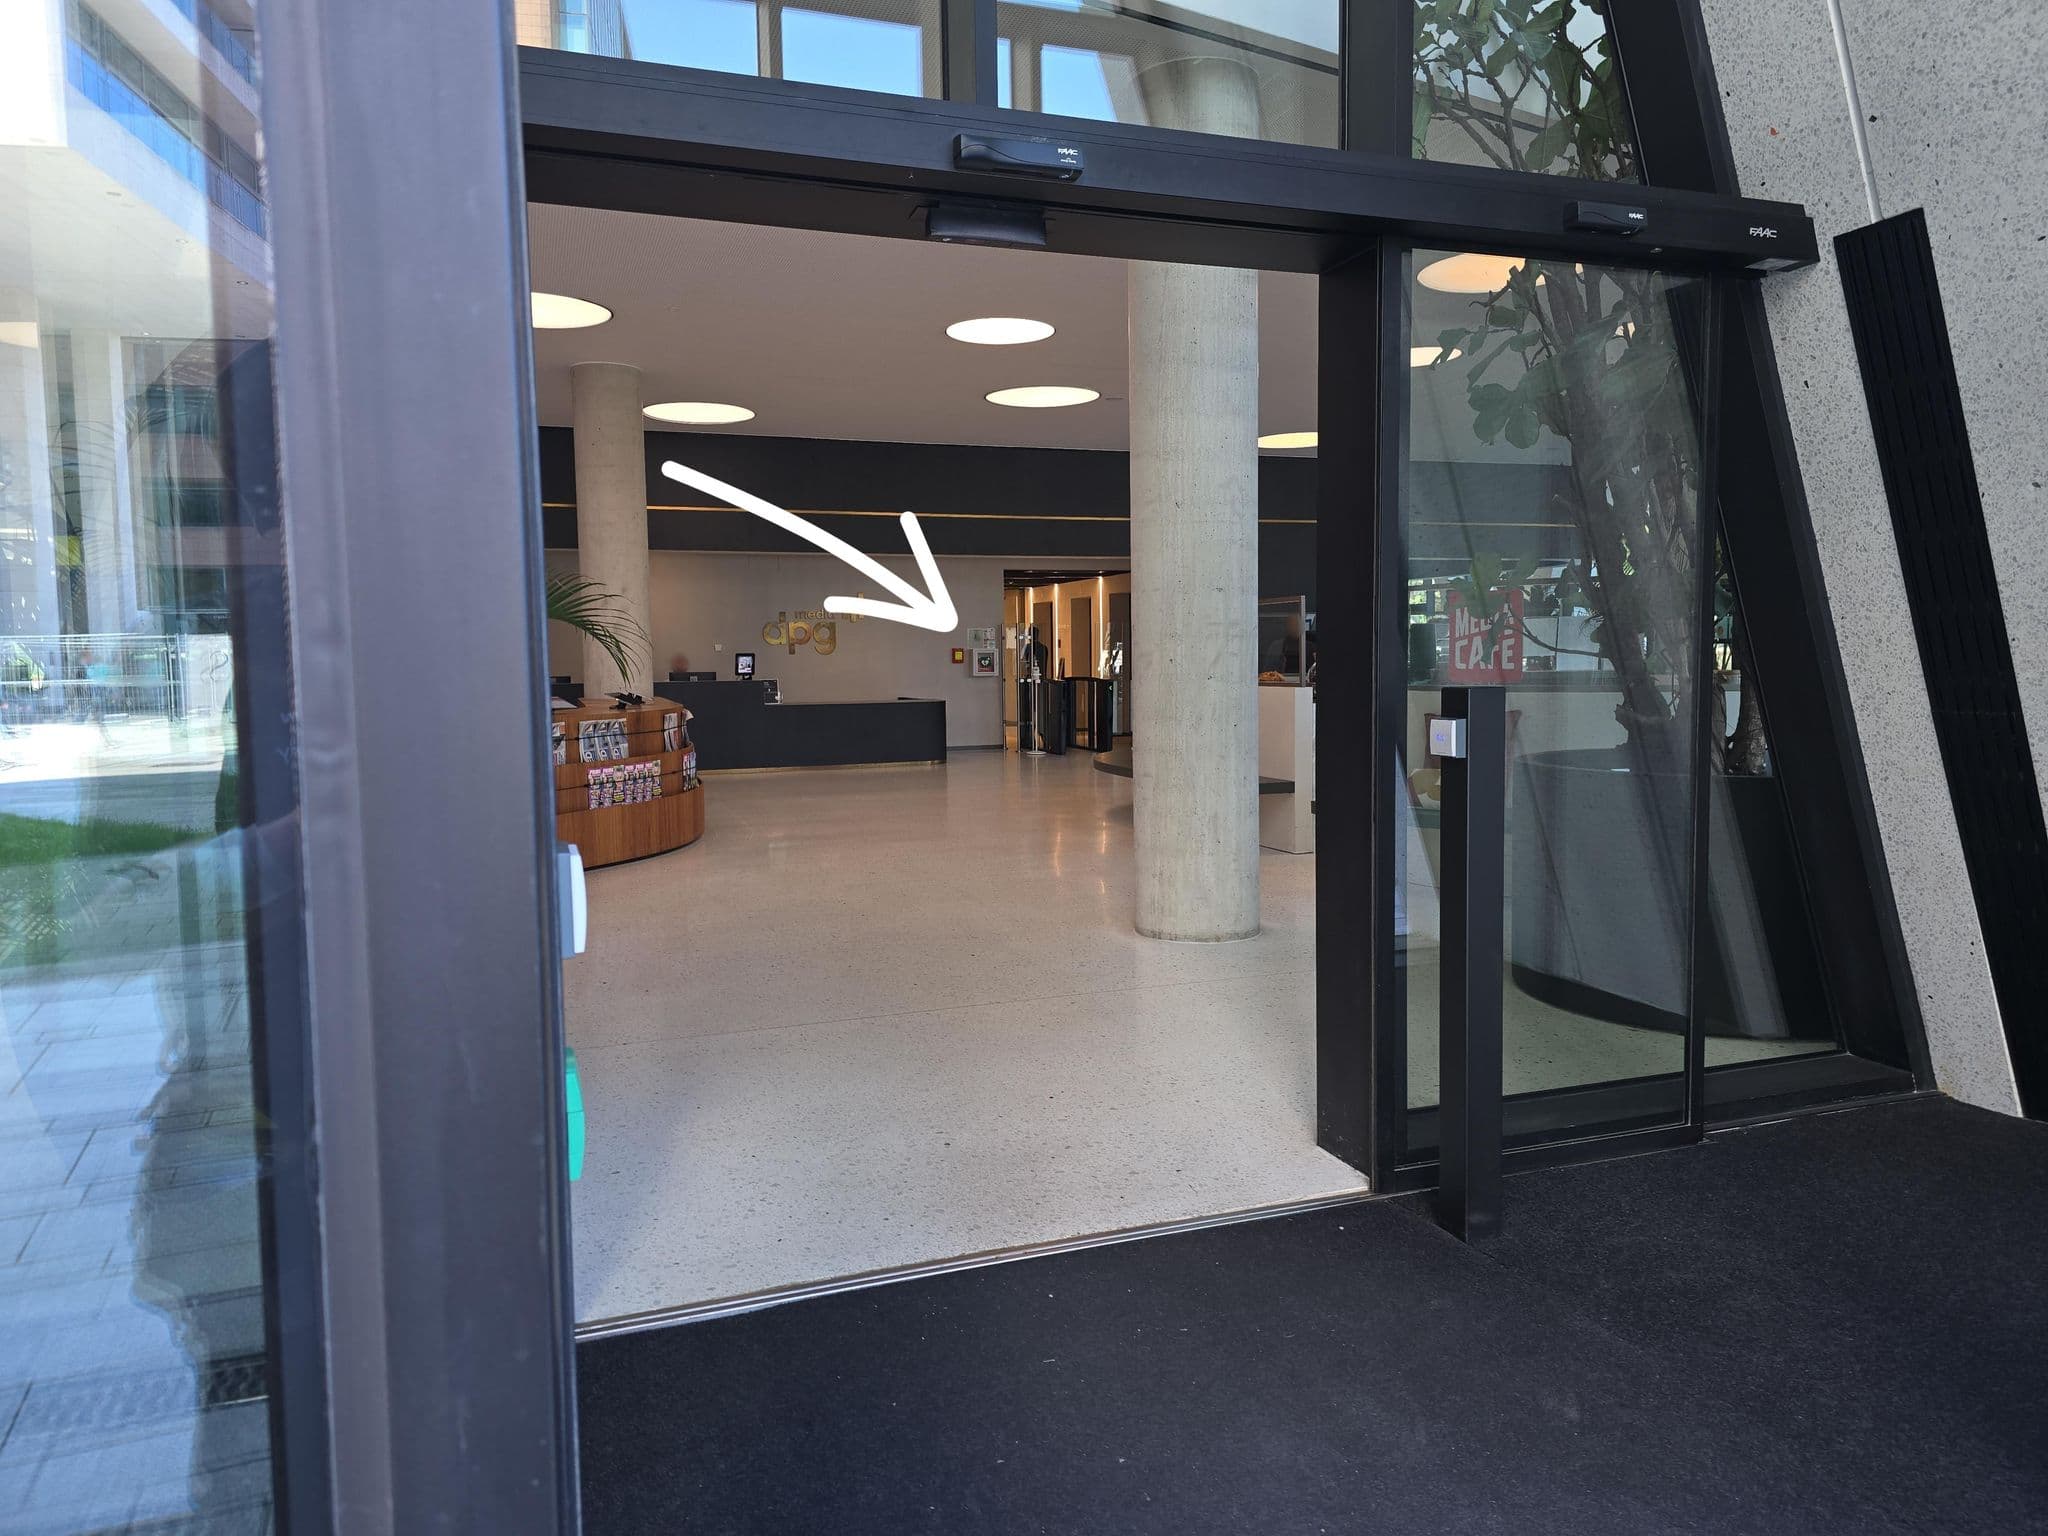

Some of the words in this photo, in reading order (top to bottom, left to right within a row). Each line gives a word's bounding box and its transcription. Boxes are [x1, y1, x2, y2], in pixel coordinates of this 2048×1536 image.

[1057, 148, 1079, 156] FAAC
[1749, 226, 1778, 238] FAAC
[1455, 602, 1515, 638] MEA
[762, 611, 837, 655] dpg
